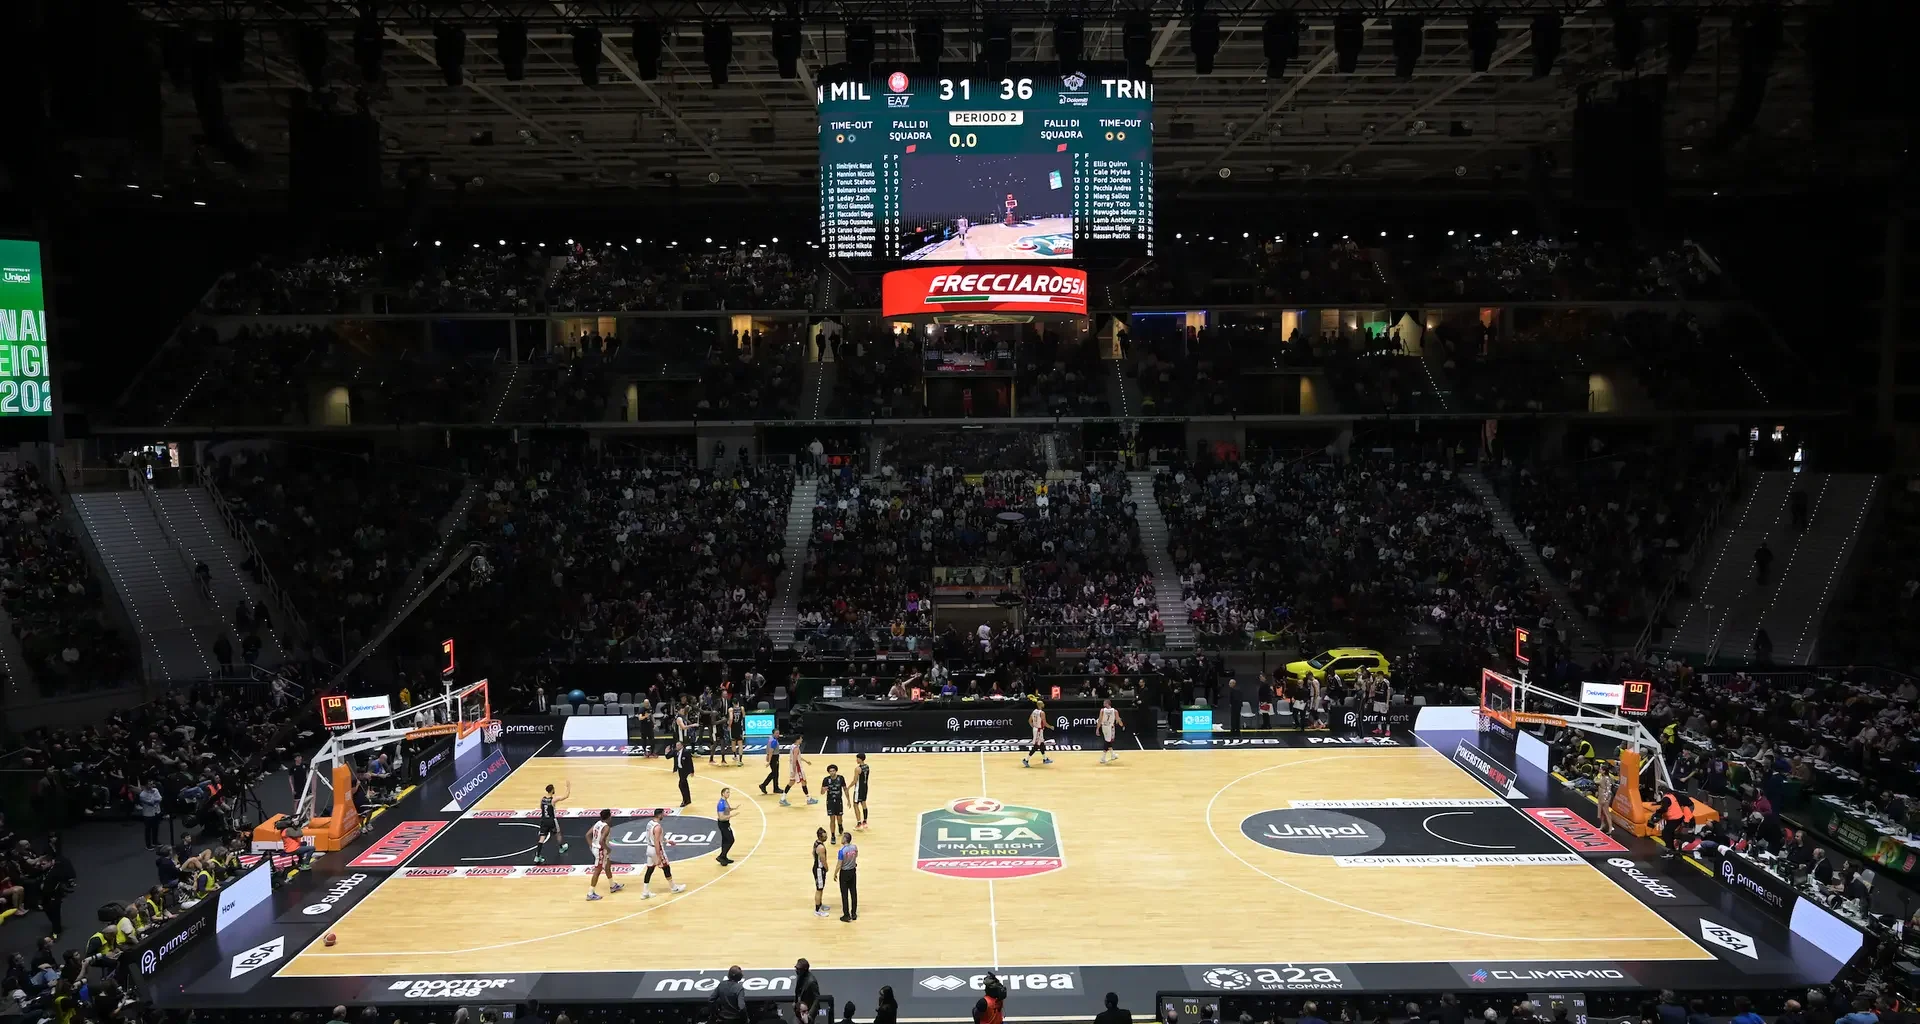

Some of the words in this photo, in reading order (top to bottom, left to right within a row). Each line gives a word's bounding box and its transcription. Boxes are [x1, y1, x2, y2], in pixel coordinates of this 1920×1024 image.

[831, 82, 870, 100] MIL
[940, 79, 970, 100] 31
[1000, 78, 1032, 100] 36
[1102, 79, 1146, 100] TRN
[888, 96, 909, 105] EA7
[892, 120, 916, 128] FALLI
[919, 120, 928, 128] DI
[956, 114, 1007, 122] PERIODO
[1010, 113, 1016, 122] 2
[1044, 120, 1068, 128] FALLI
[1100, 119, 1142, 128] TIME-OUT
[830, 121, 874, 130] TIME-OUT
[890, 132, 932, 141] SQUADRA
[950, 133, 977, 148] 0.0
[1040, 130, 1083, 140] SQUADRA
[4, 272, 30, 283] Unipol
[928, 274, 1084, 295] FRECCIAROSSA
[506, 724, 554, 734] primerent
[853, 719, 902, 730] primerent
[964, 718, 1012, 728] primerent
[1163, 738, 1280, 746] FASTWEB
[455, 770, 488, 800] QUIGIOCO
[487, 757, 505, 774] NEWS
[937, 827, 1044, 841] LBA
[1268, 824, 1366, 838] Unipol
[1536, 810, 1610, 848] UMANA
[360, 823, 436, 864] UMANA
[622, 831, 716, 847] Uipol
[924, 860, 1058, 868] FRECCIAROSSA
[321, 873, 367, 904] subito
[1620, 866, 1676, 899] subito
[1737, 873, 1783, 908] primerent
[222, 901, 236, 914] How
[159, 917, 206, 961] primerent
[1705, 927, 1748, 950] IBSA
[235, 943, 282, 969] IBSA
[1254, 967, 1340, 983] a2a
[1491, 970, 1624, 979] CLIMAMIO
[411, 979, 507, 989] DOCTOR
[404, 988, 483, 998] GLASS
[1184, 1004, 1198, 1014] 0.0
